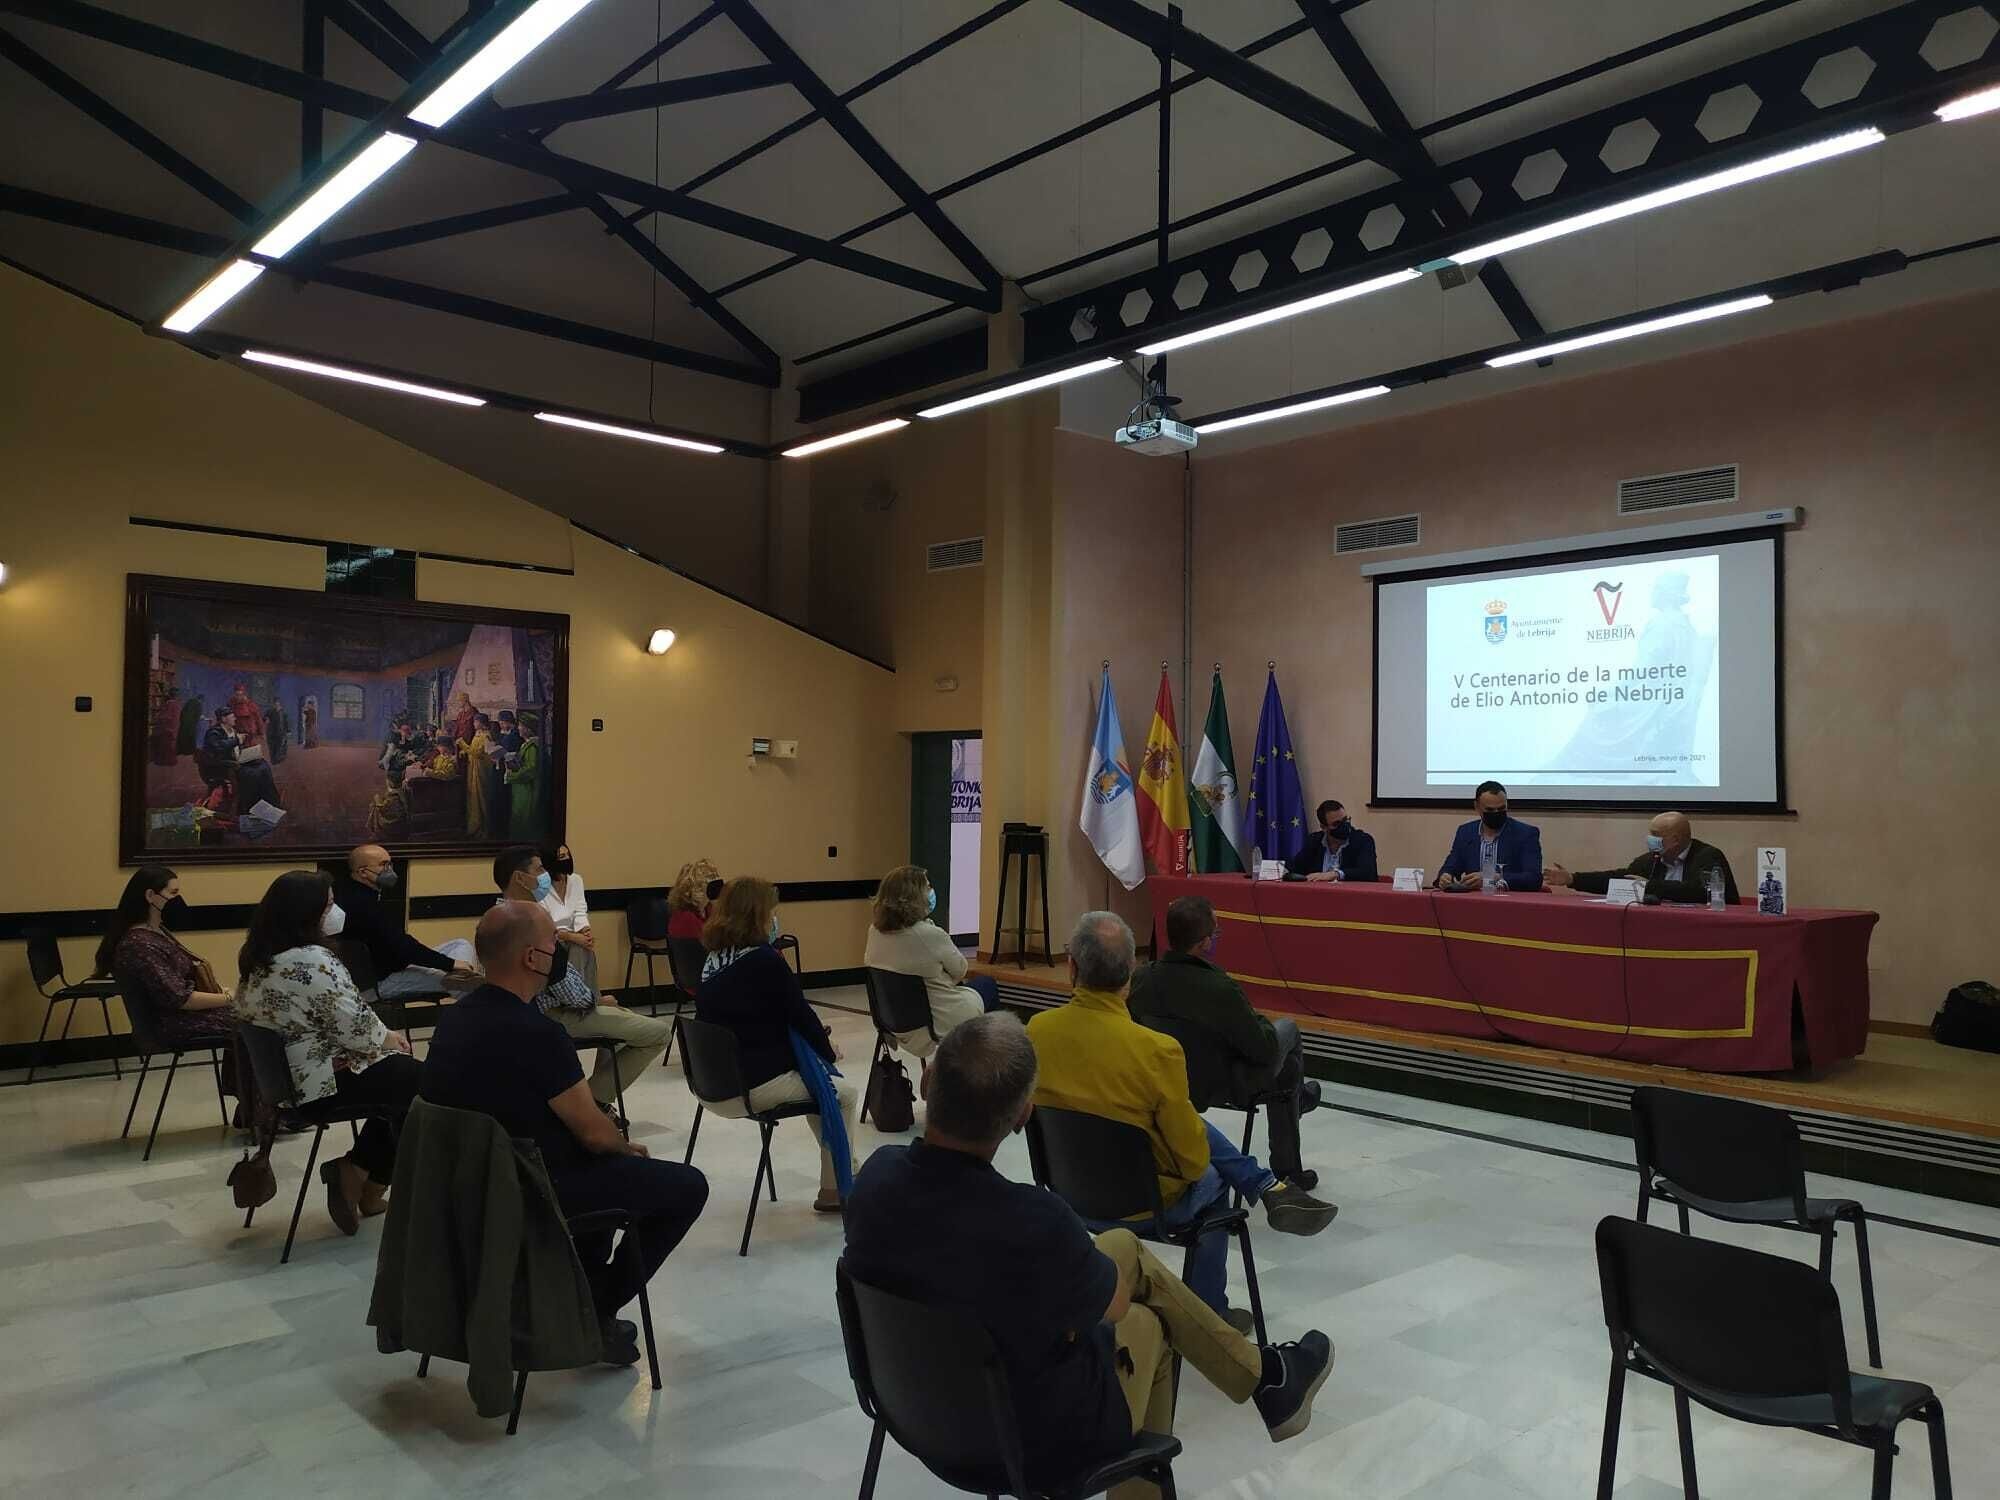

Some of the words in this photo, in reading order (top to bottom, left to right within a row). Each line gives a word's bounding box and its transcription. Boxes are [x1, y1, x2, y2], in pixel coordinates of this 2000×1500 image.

[1587, 626, 1635, 640] NEBRIJA
[1453, 674, 1465, 689] V
[1470, 668, 1560, 689] Centenario
[1567, 667, 1589, 684] de
[1596, 665, 1611, 682] la
[1618, 663, 1688, 682] muerte
[1450, 692, 1470, 709] de
[1476, 691, 1504, 708] Elio
[1510, 690, 1579, 707] Antonio
[1585, 686, 1608, 704] de
[1615, 683, 1685, 705] Nebrija
[1690, 753, 1706, 761] 2021
